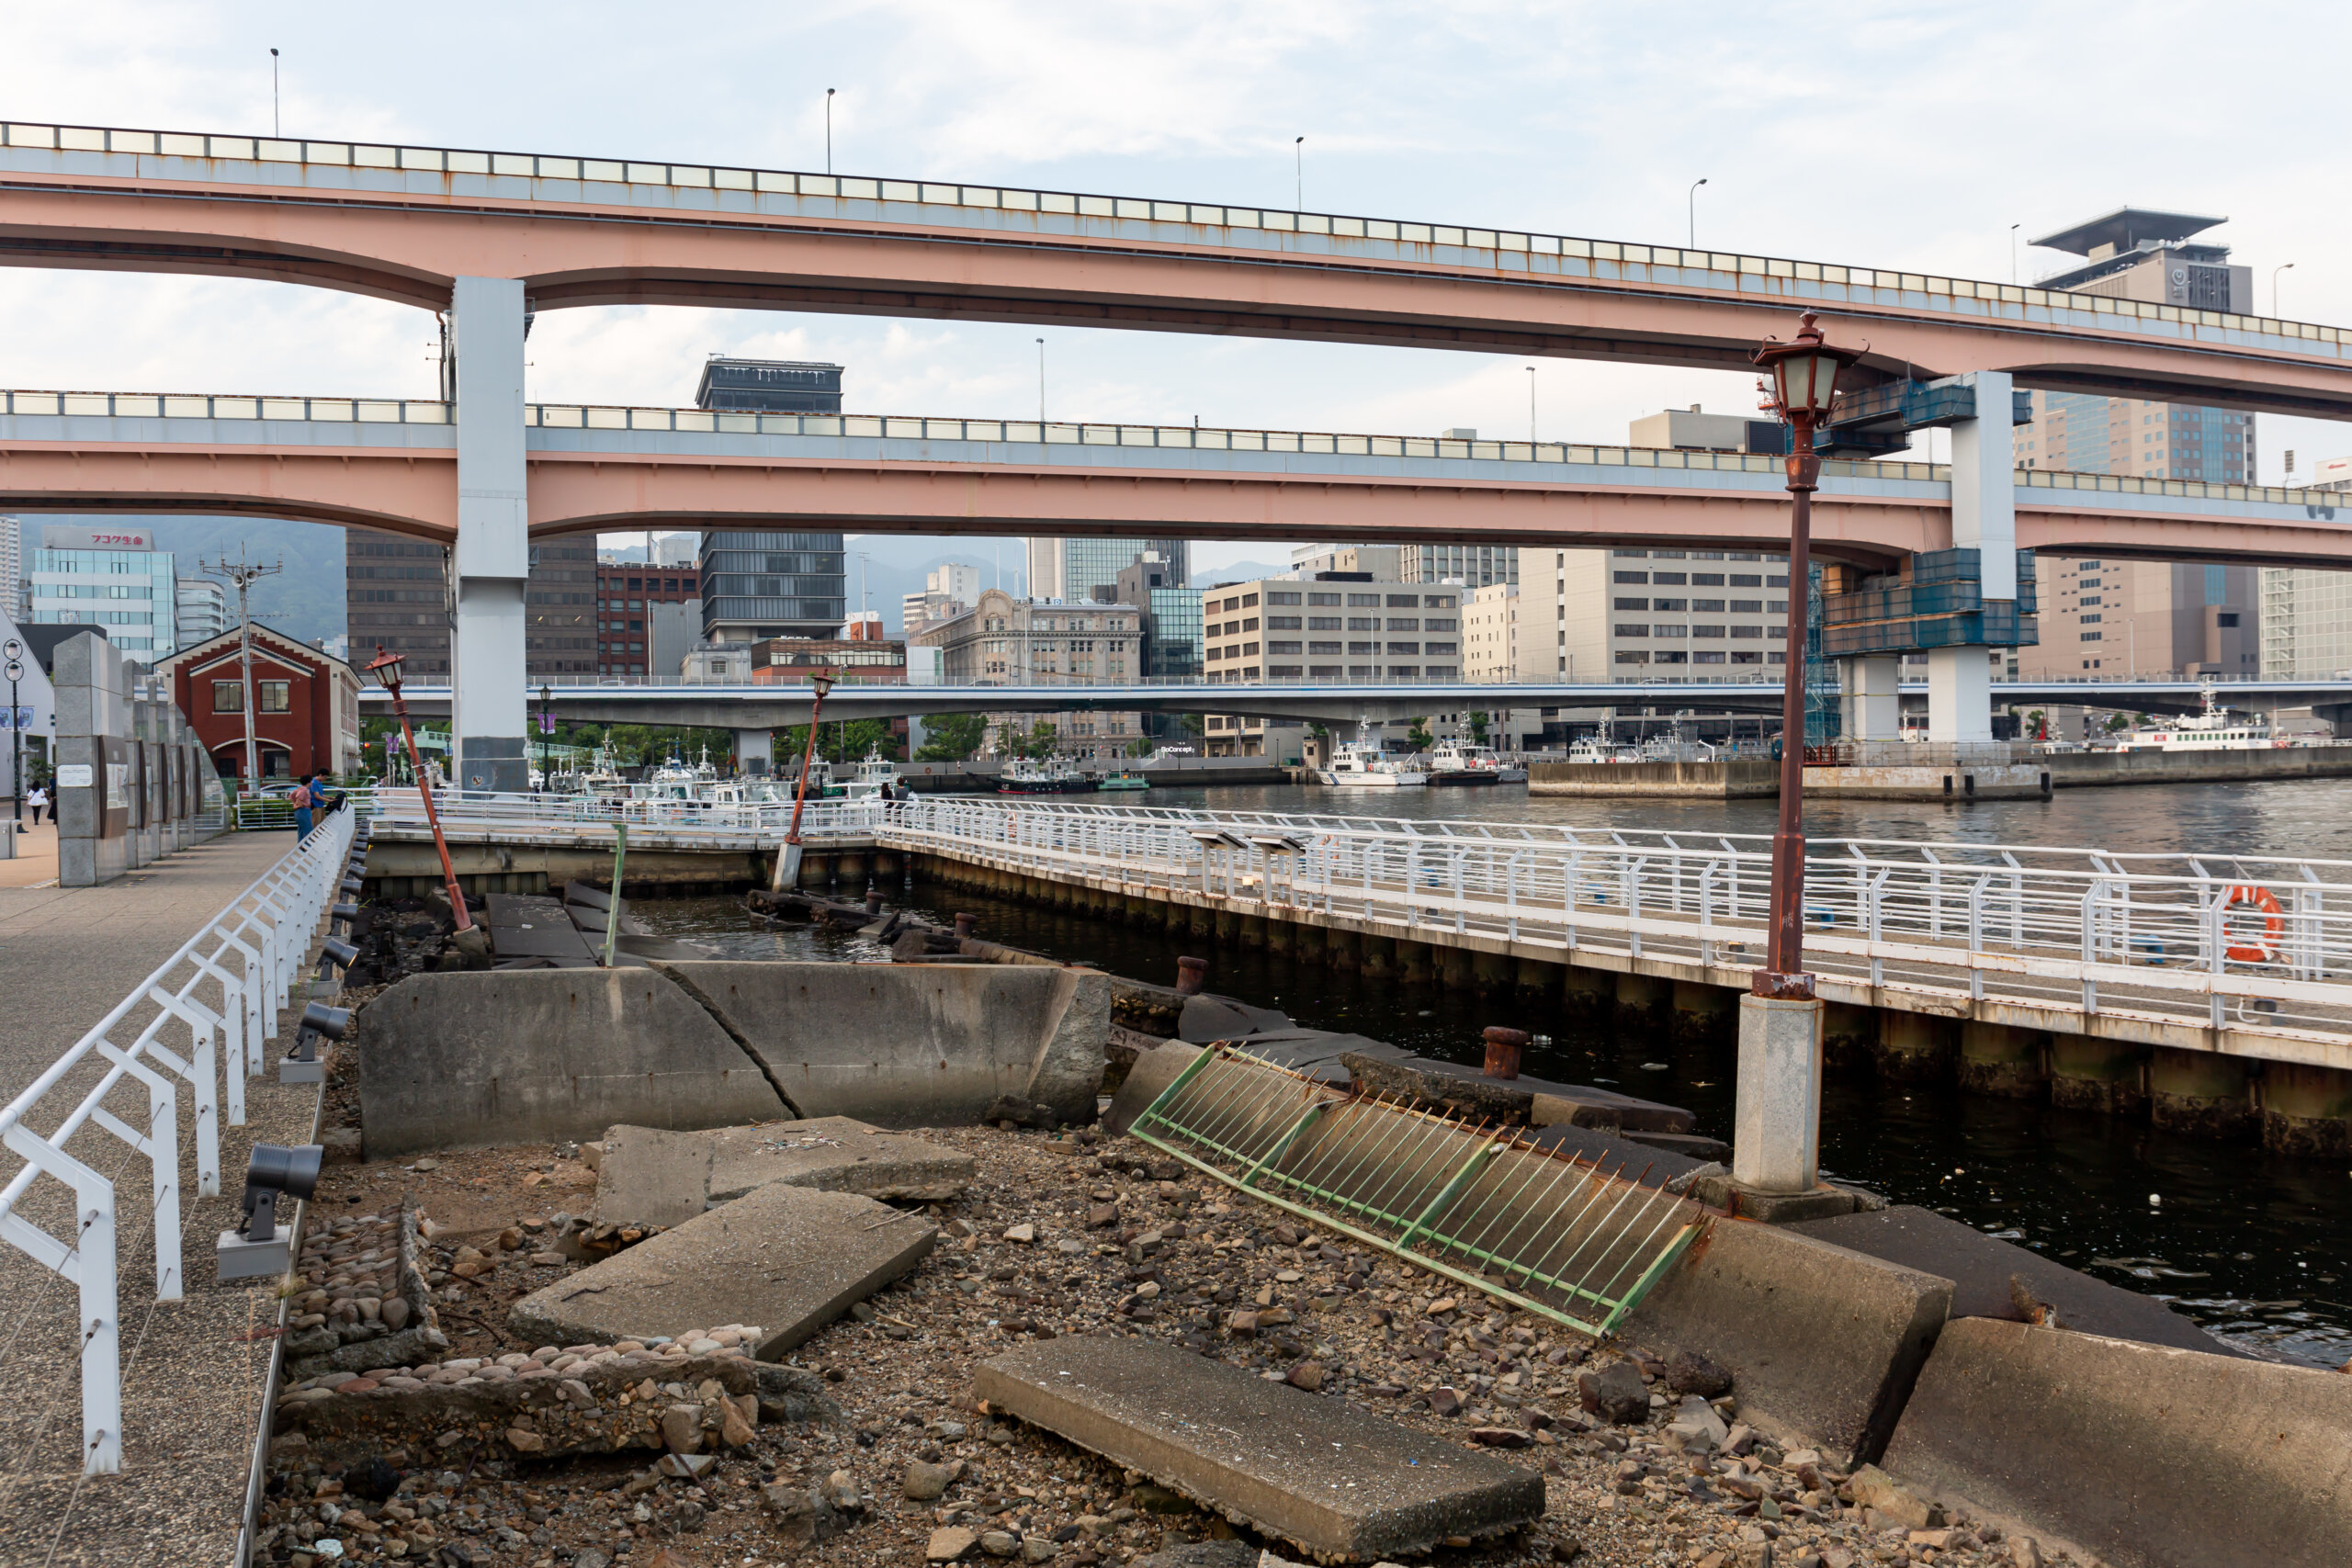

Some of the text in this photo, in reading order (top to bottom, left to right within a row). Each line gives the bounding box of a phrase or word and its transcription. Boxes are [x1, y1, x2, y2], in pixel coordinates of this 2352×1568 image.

[92, 536, 142, 545] フコク生命
